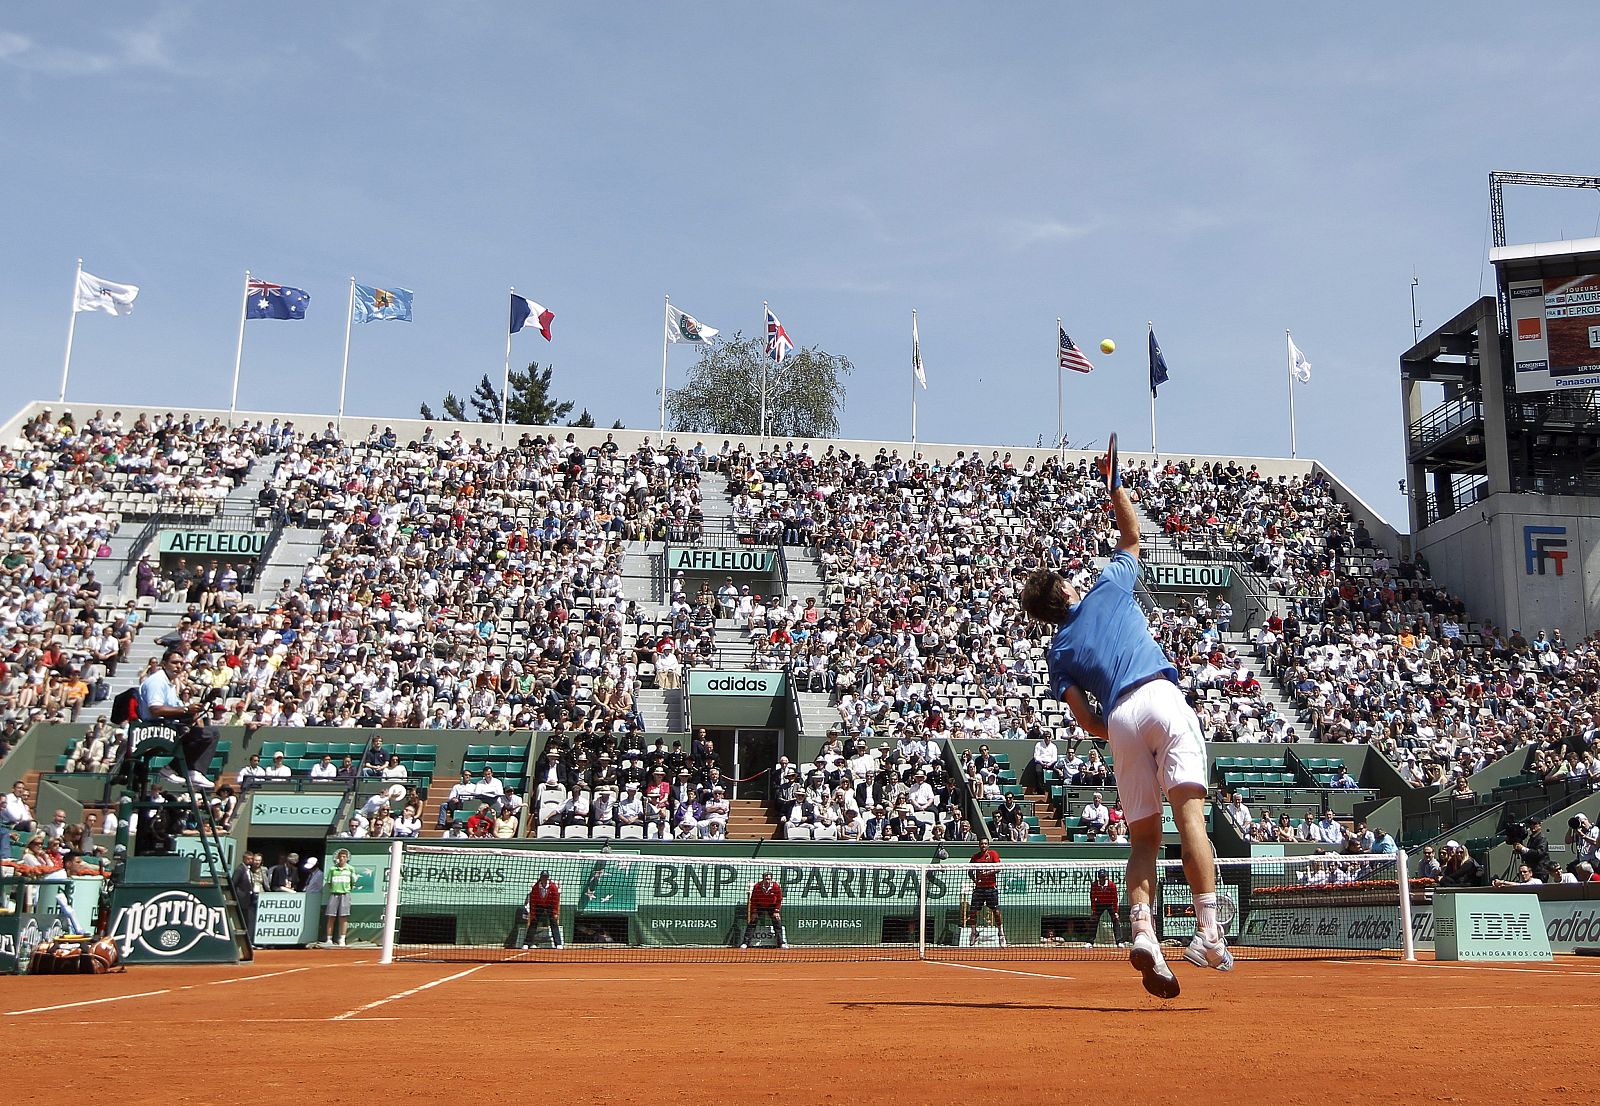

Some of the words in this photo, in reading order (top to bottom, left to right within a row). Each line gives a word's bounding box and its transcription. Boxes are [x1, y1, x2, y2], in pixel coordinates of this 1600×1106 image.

[1566, 285, 1598, 293] JOUEURS
[1519, 332, 1540, 340] orange
[1518, 361, 1546, 369] LONGINES
[170, 533, 265, 553] AFFLELOU
[1524, 525, 1568, 577] FFT
[678, 550, 766, 571] AFFLELOU
[708, 676, 767, 692] adidas
[269, 806, 341, 816] PEUGEOT
[427, 867, 506, 885] PARIBAS
[655, 864, 738, 898] BNP
[780, 865, 948, 900] PARIBAS
[1034, 870, 1068, 886] BNP
[259, 900, 302, 909] AFFLELOU
[258, 913, 300, 923] AFFLELOU
[651, 919, 673, 929] BNP
[674, 919, 718, 929] PARIBAS
[798, 919, 819, 928] BNP
[820, 919, 862, 928] PARIBAS
[256, 927, 300, 937] AFFLELOU
[1347, 914, 1394, 940] adidas
[1470, 913, 1531, 940] IBM
